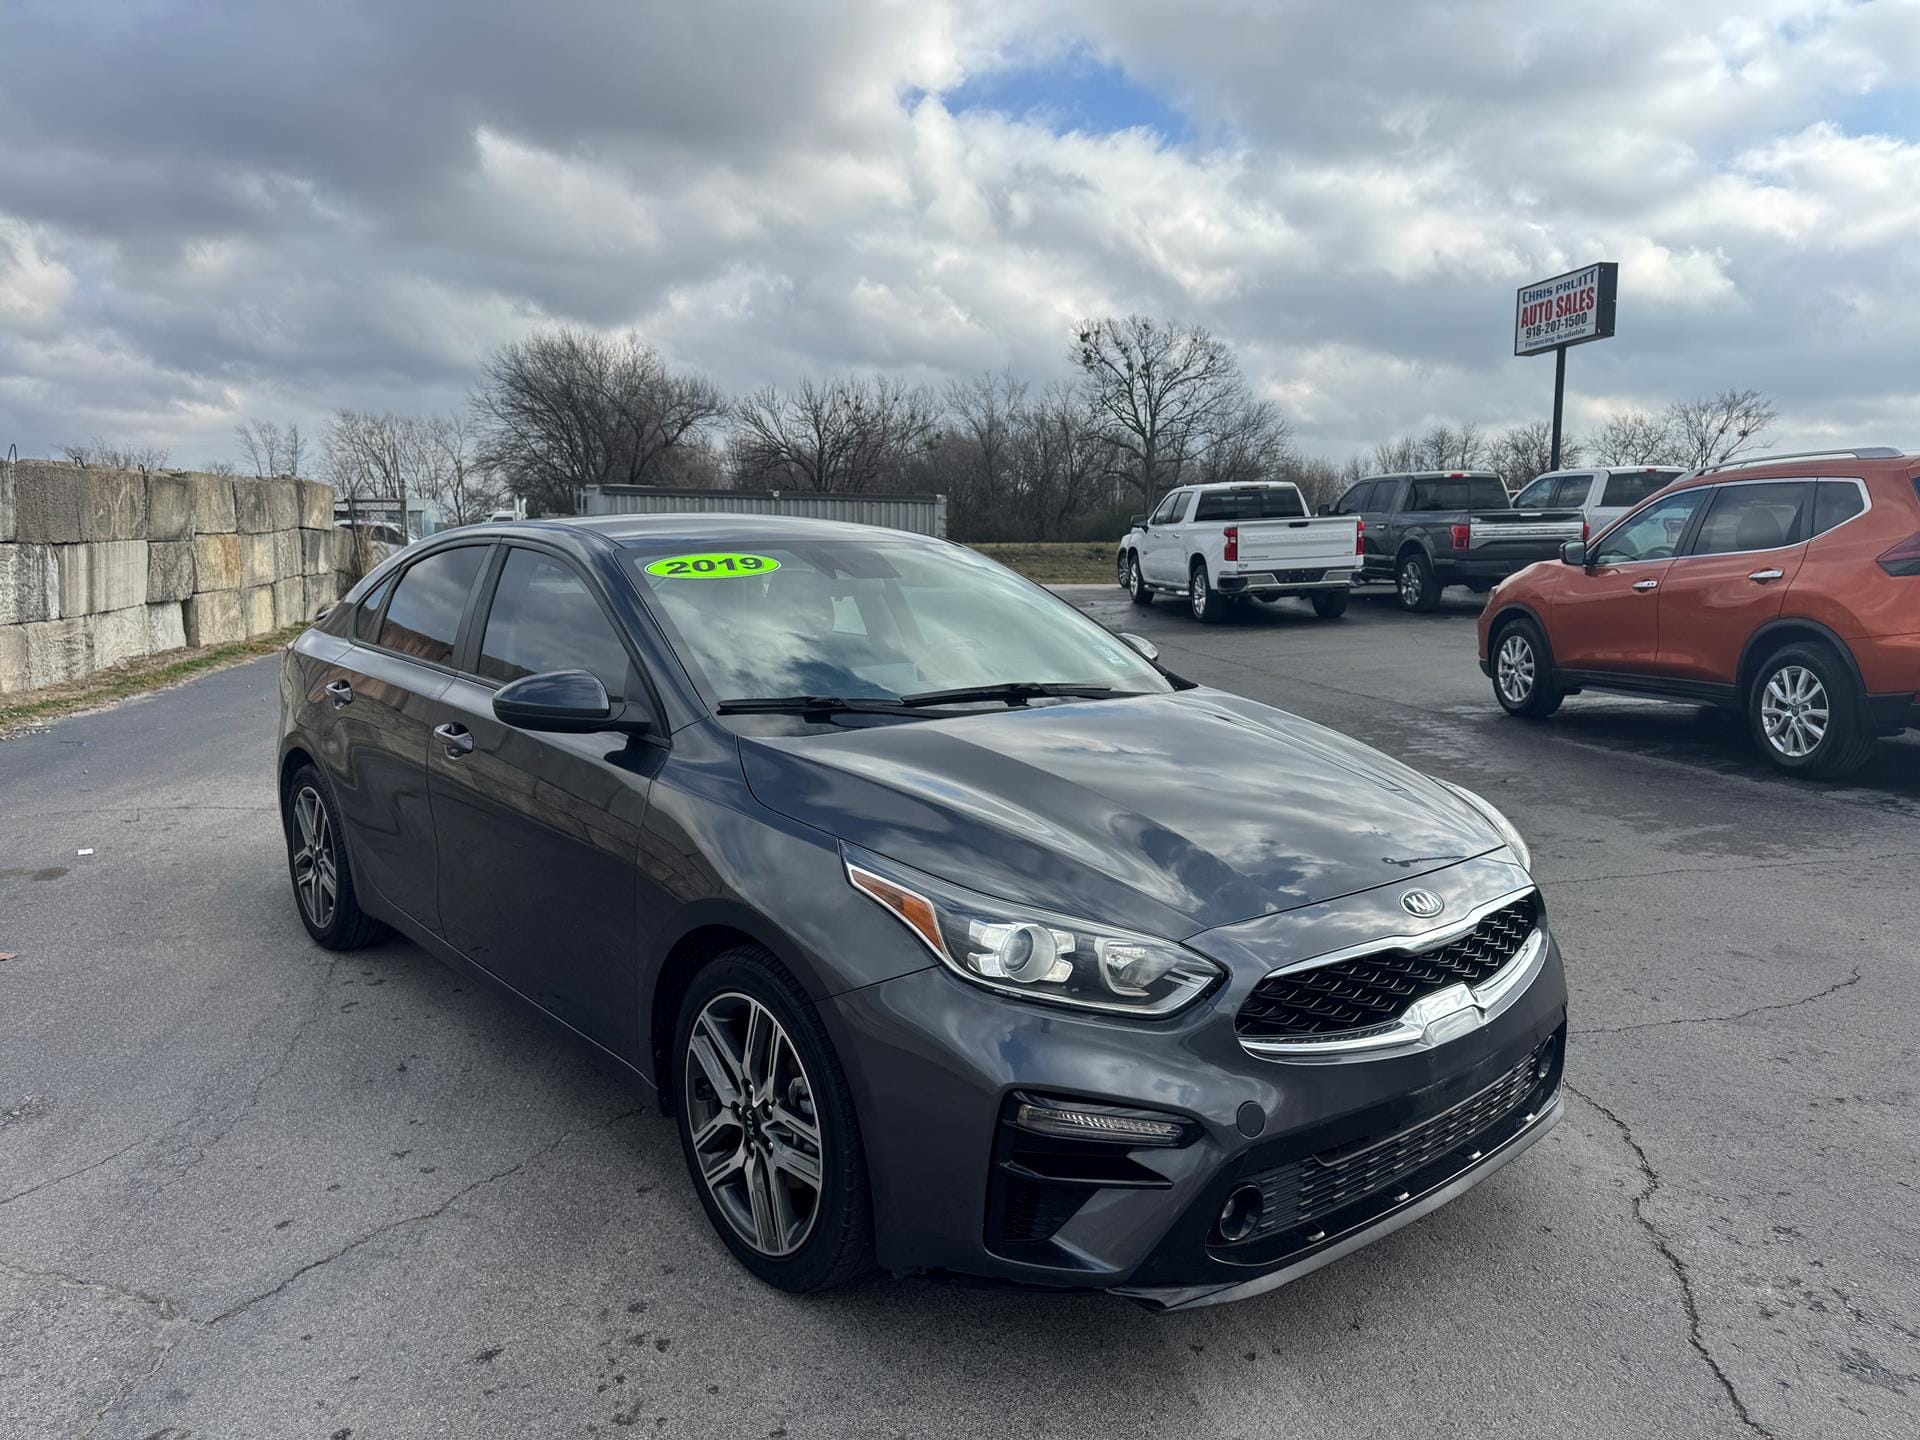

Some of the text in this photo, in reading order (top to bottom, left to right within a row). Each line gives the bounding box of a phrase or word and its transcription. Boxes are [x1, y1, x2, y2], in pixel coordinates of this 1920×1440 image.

[1522, 268, 1596, 304] CHRIS PRUITT
[1521, 286, 1595, 328] AUTO SALES
[1526, 311, 1588, 339] 918-207-1500
[1525, 327, 1586, 348] Financing Available
[665, 557, 763, 575] 2019
[1405, 892, 1441, 913] KIA
